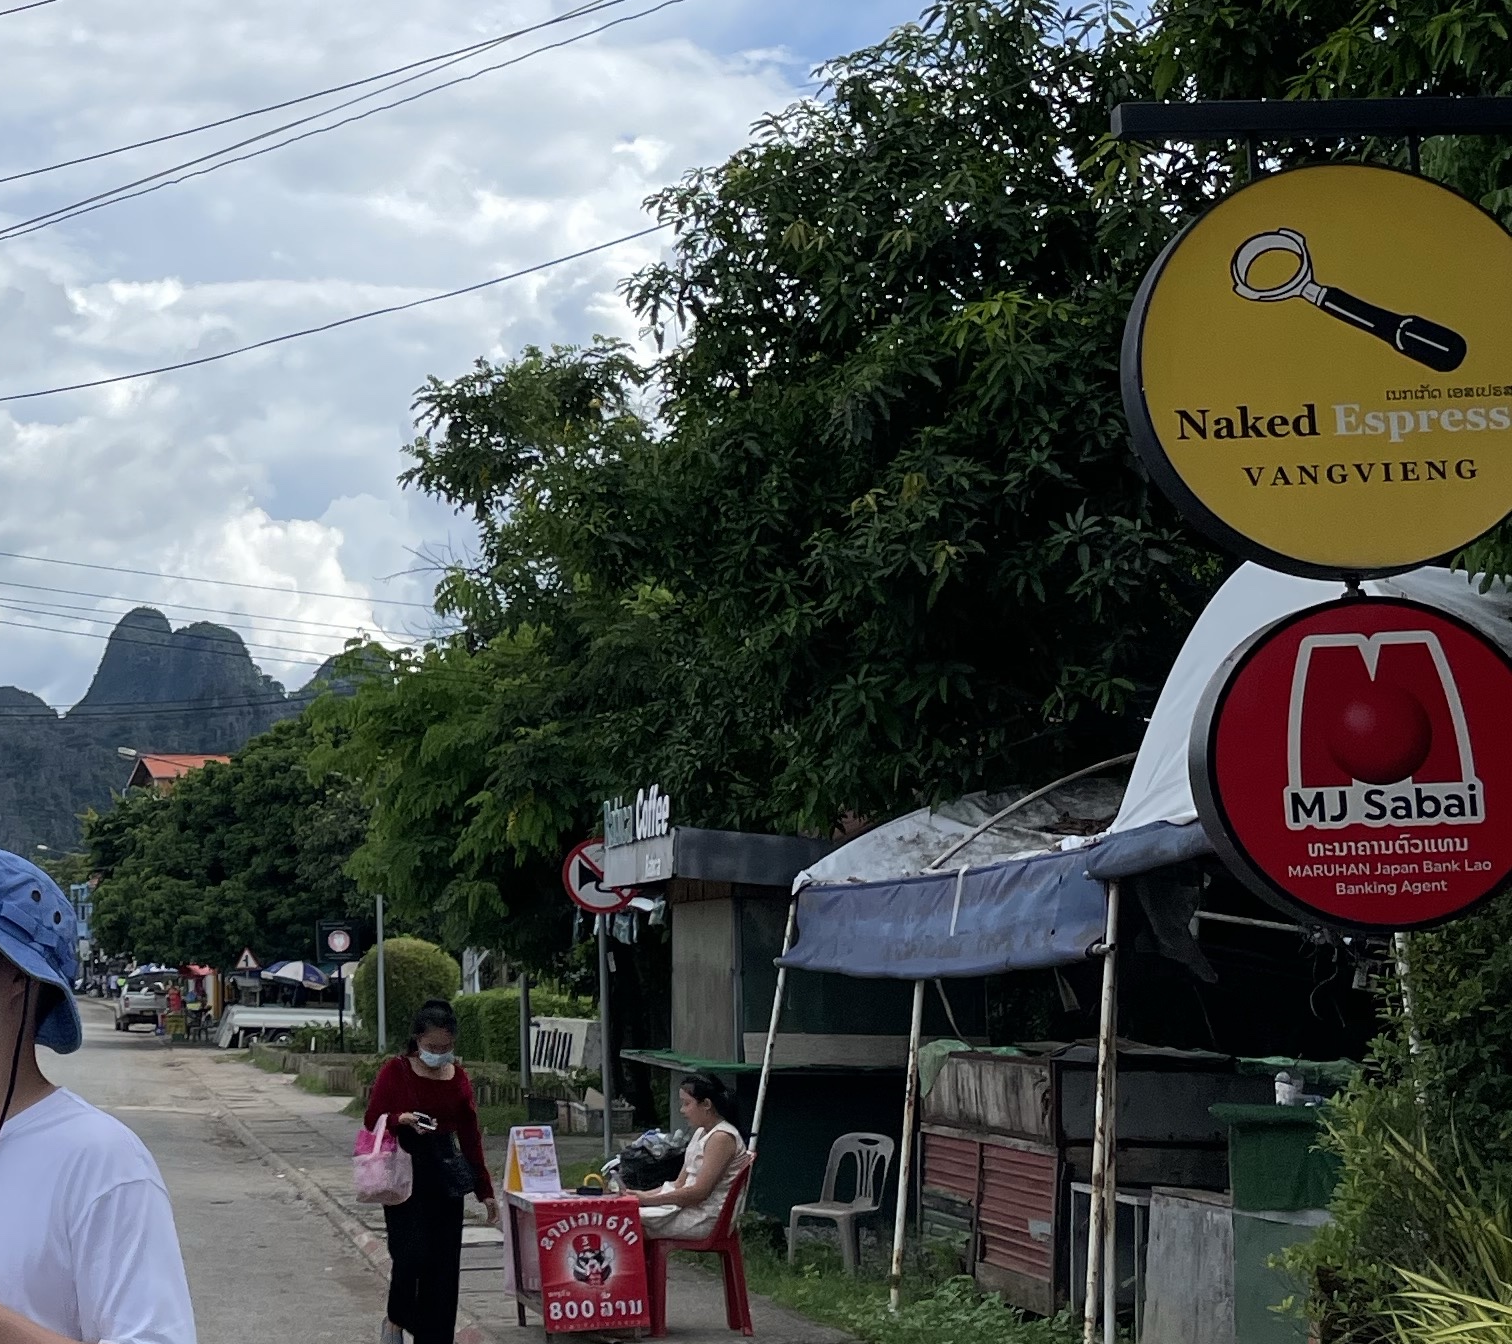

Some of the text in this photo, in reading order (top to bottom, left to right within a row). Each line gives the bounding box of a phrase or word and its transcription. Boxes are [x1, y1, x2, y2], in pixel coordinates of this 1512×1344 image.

[1174, 403, 1512, 443] Naked Espress
[1241, 459, 1479, 487] VANGVIENG
[636, 783, 670, 840] Coffee
[1289, 783, 1478, 824] MJ Sabai
[1288, 858, 1492, 878] MARUHAN Japan Bank Lao
[1336, 880, 1448, 896] Banking Agent
[549, 1299, 595, 1320] 800
